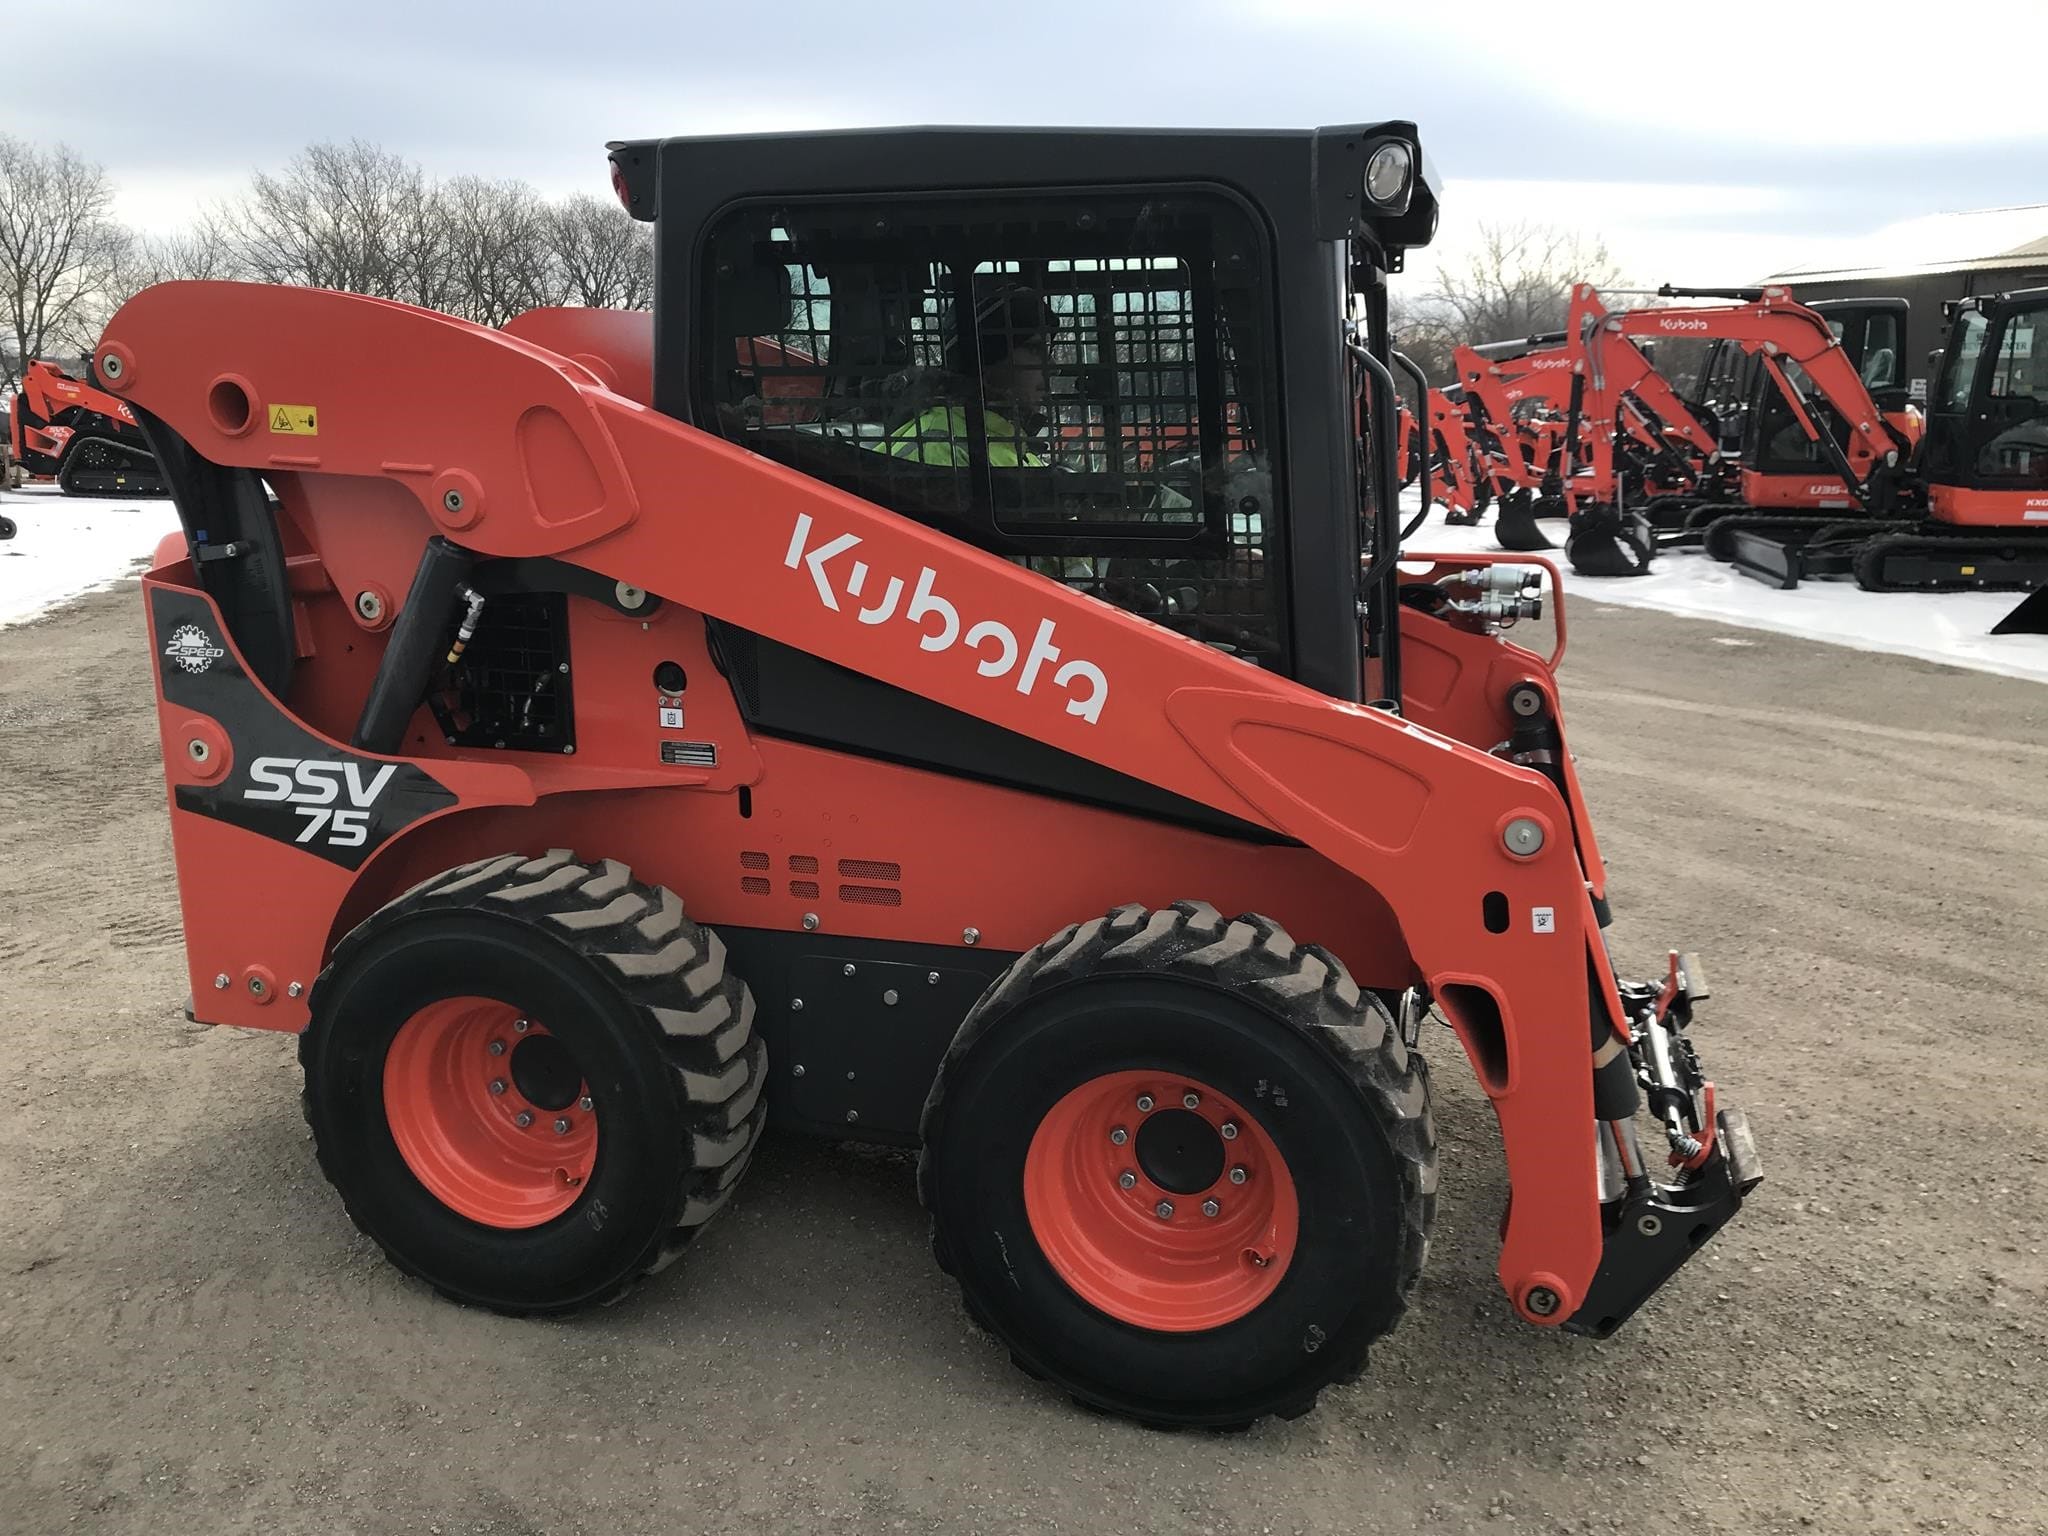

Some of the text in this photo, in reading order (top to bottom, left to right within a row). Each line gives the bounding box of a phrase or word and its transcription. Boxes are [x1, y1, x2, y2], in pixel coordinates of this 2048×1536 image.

[1660, 319, 1708, 330] Kubota
[784, 512, 1109, 725] Kubota
[244, 757, 398, 807] SSV
[295, 807, 370, 846] 75
